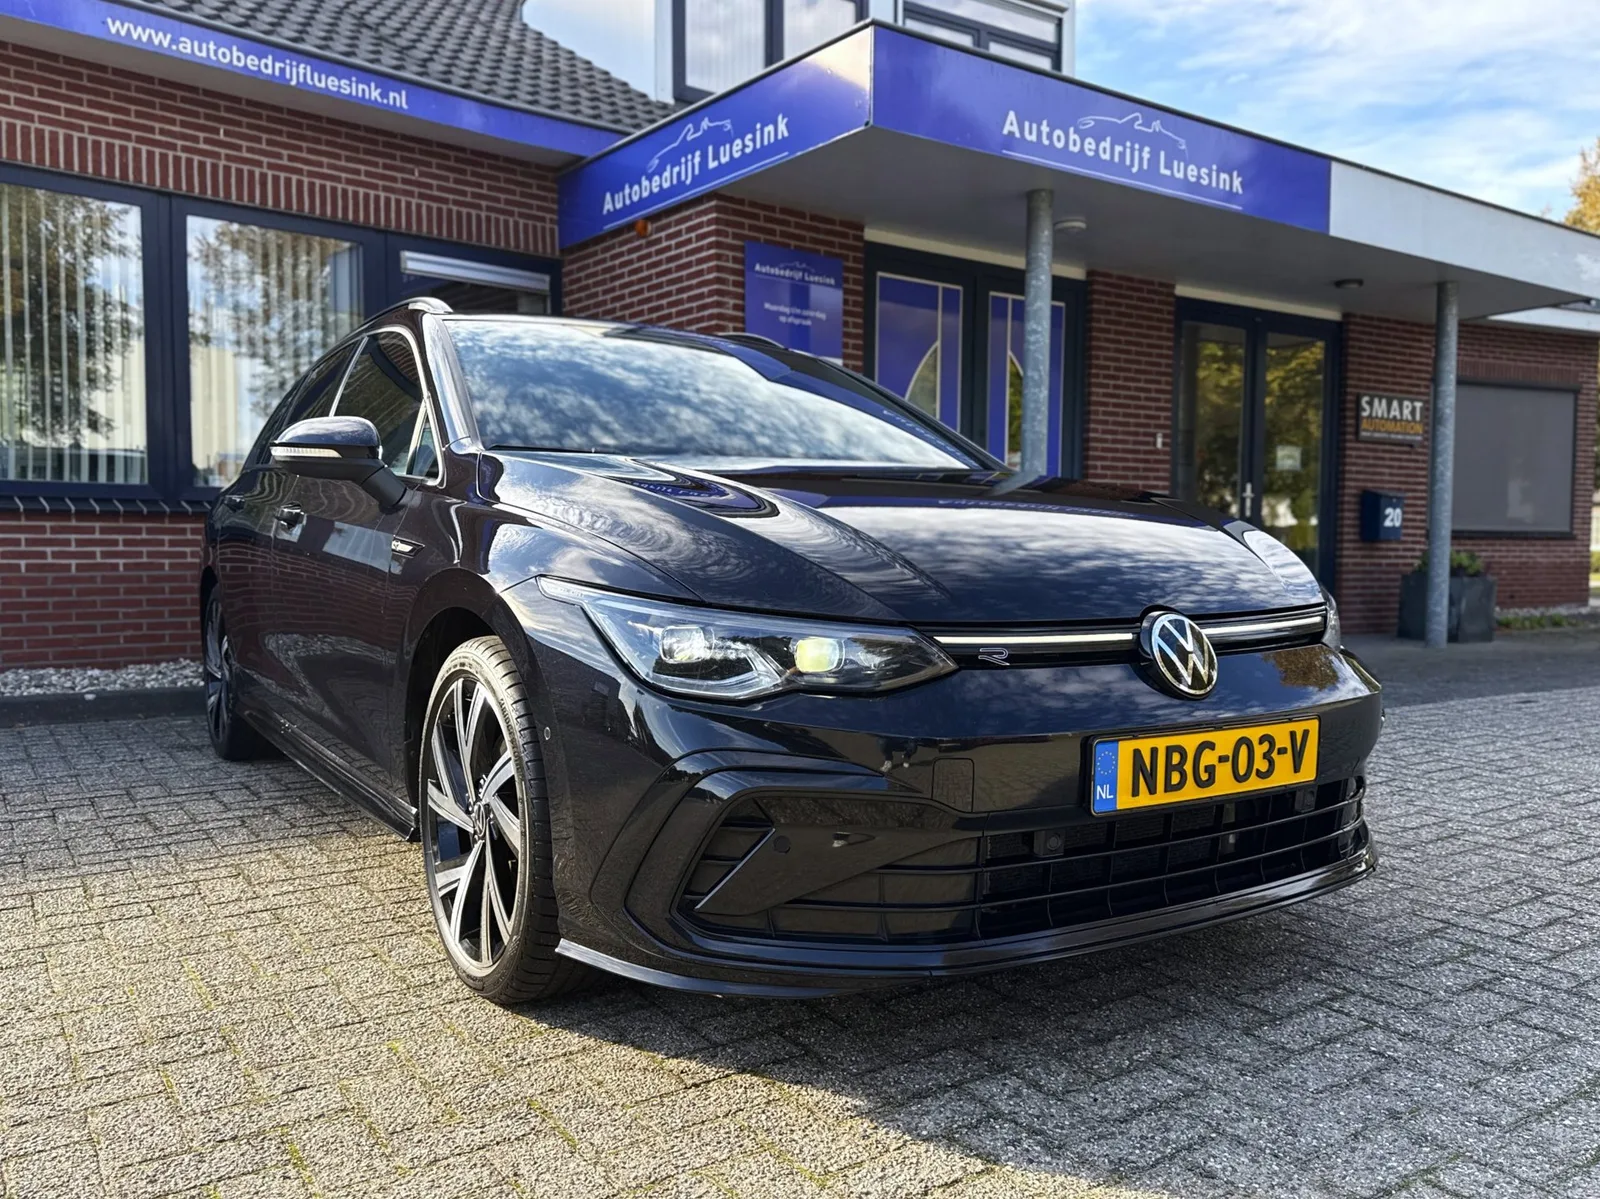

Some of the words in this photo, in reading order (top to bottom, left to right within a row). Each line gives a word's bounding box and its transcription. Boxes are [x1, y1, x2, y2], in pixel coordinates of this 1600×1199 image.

[106, 17, 408, 109] www.autobedrijfluesink.nl
[602, 149, 701, 215] Autobedrijf
[707, 113, 789, 170] Luesink
[1002, 110, 1151, 173] Autobedrijf
[1159, 150, 1243, 194] Luesink
[754, 263, 803, 280] Autobedrijf
[804, 271, 836, 286] Luesink
[1360, 396, 1424, 421] SMART
[1361, 418, 1424, 434] AUTOMATION
[1383, 507, 1403, 528] 20
[1131, 729, 1310, 798] NBG-03-V
[1096, 784, 1114, 800] NL
